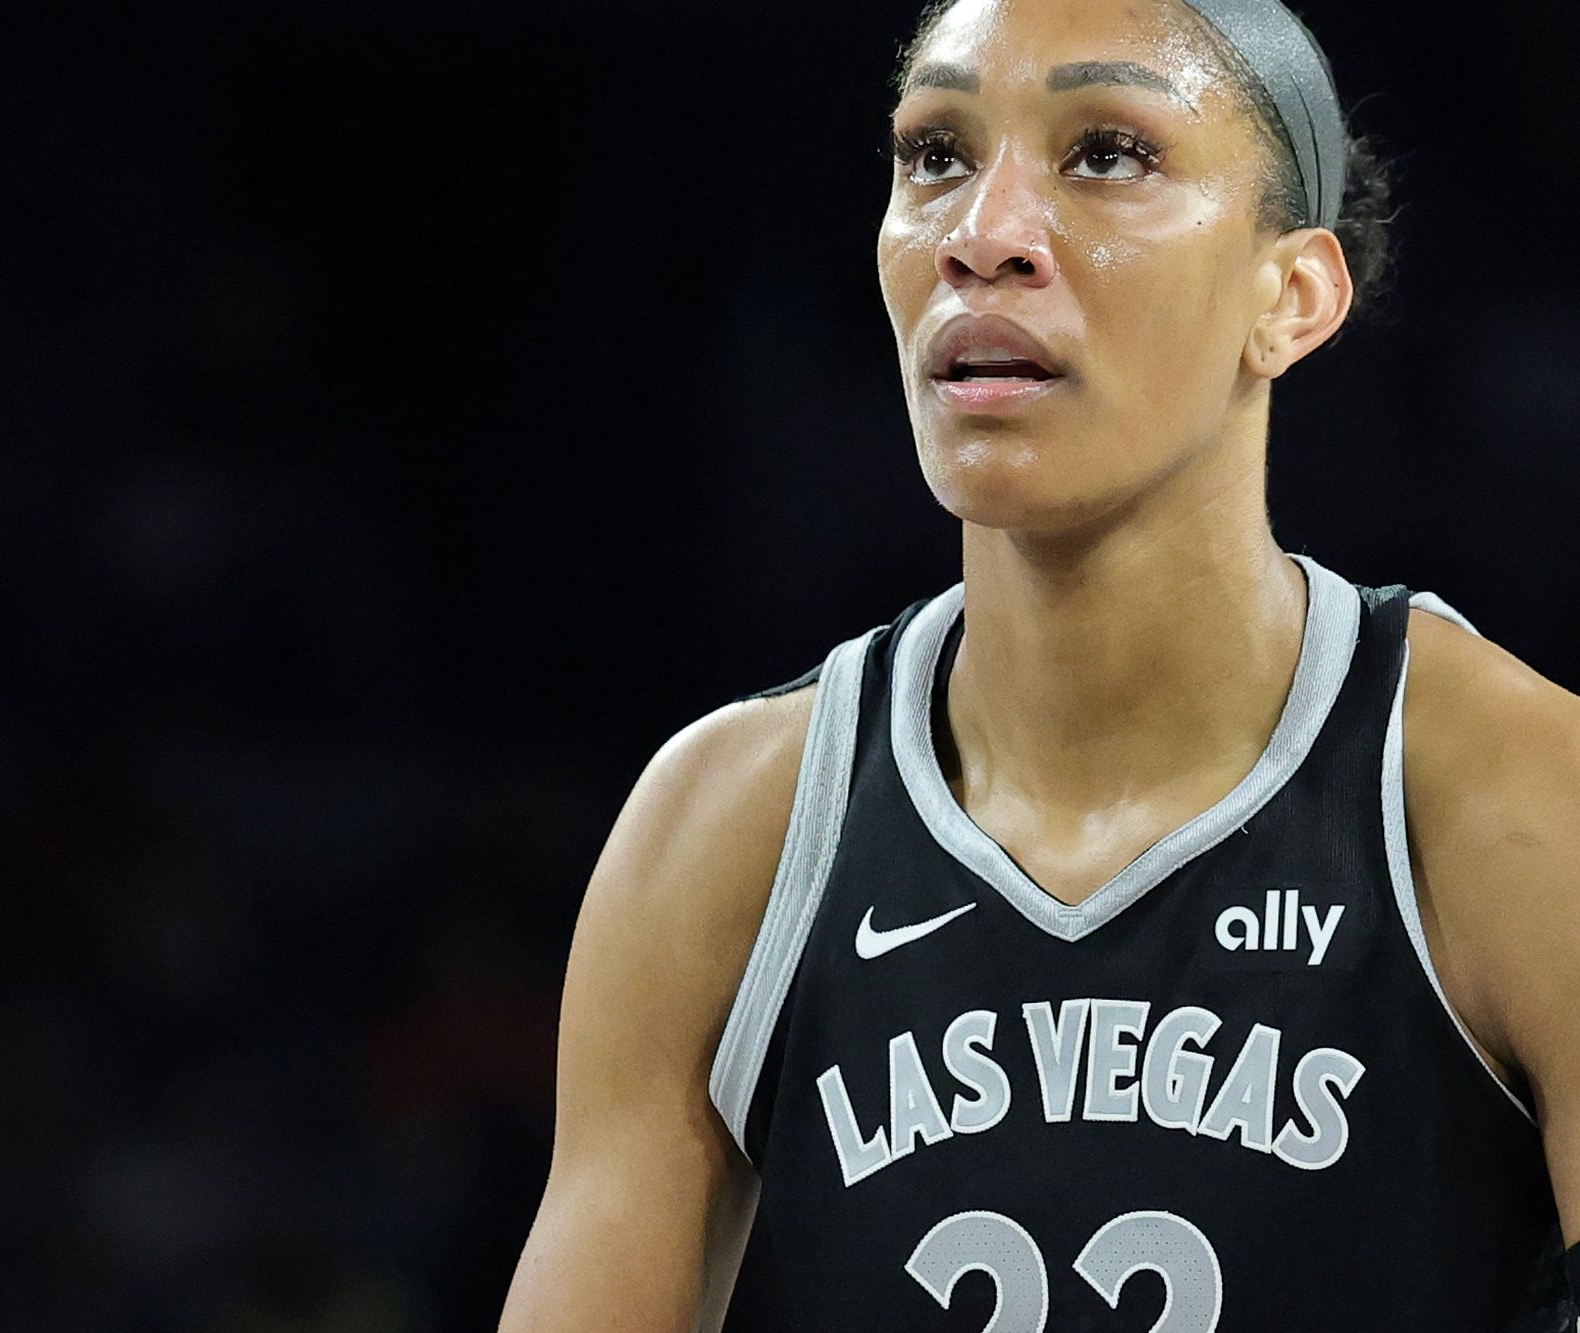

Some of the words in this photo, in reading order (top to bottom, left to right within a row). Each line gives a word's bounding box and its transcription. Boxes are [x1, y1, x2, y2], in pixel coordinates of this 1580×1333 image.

[1214, 888, 1346, 966] ally
[816, 1009, 1013, 1188] LAS
[1021, 997, 1366, 1171] VEGAS
